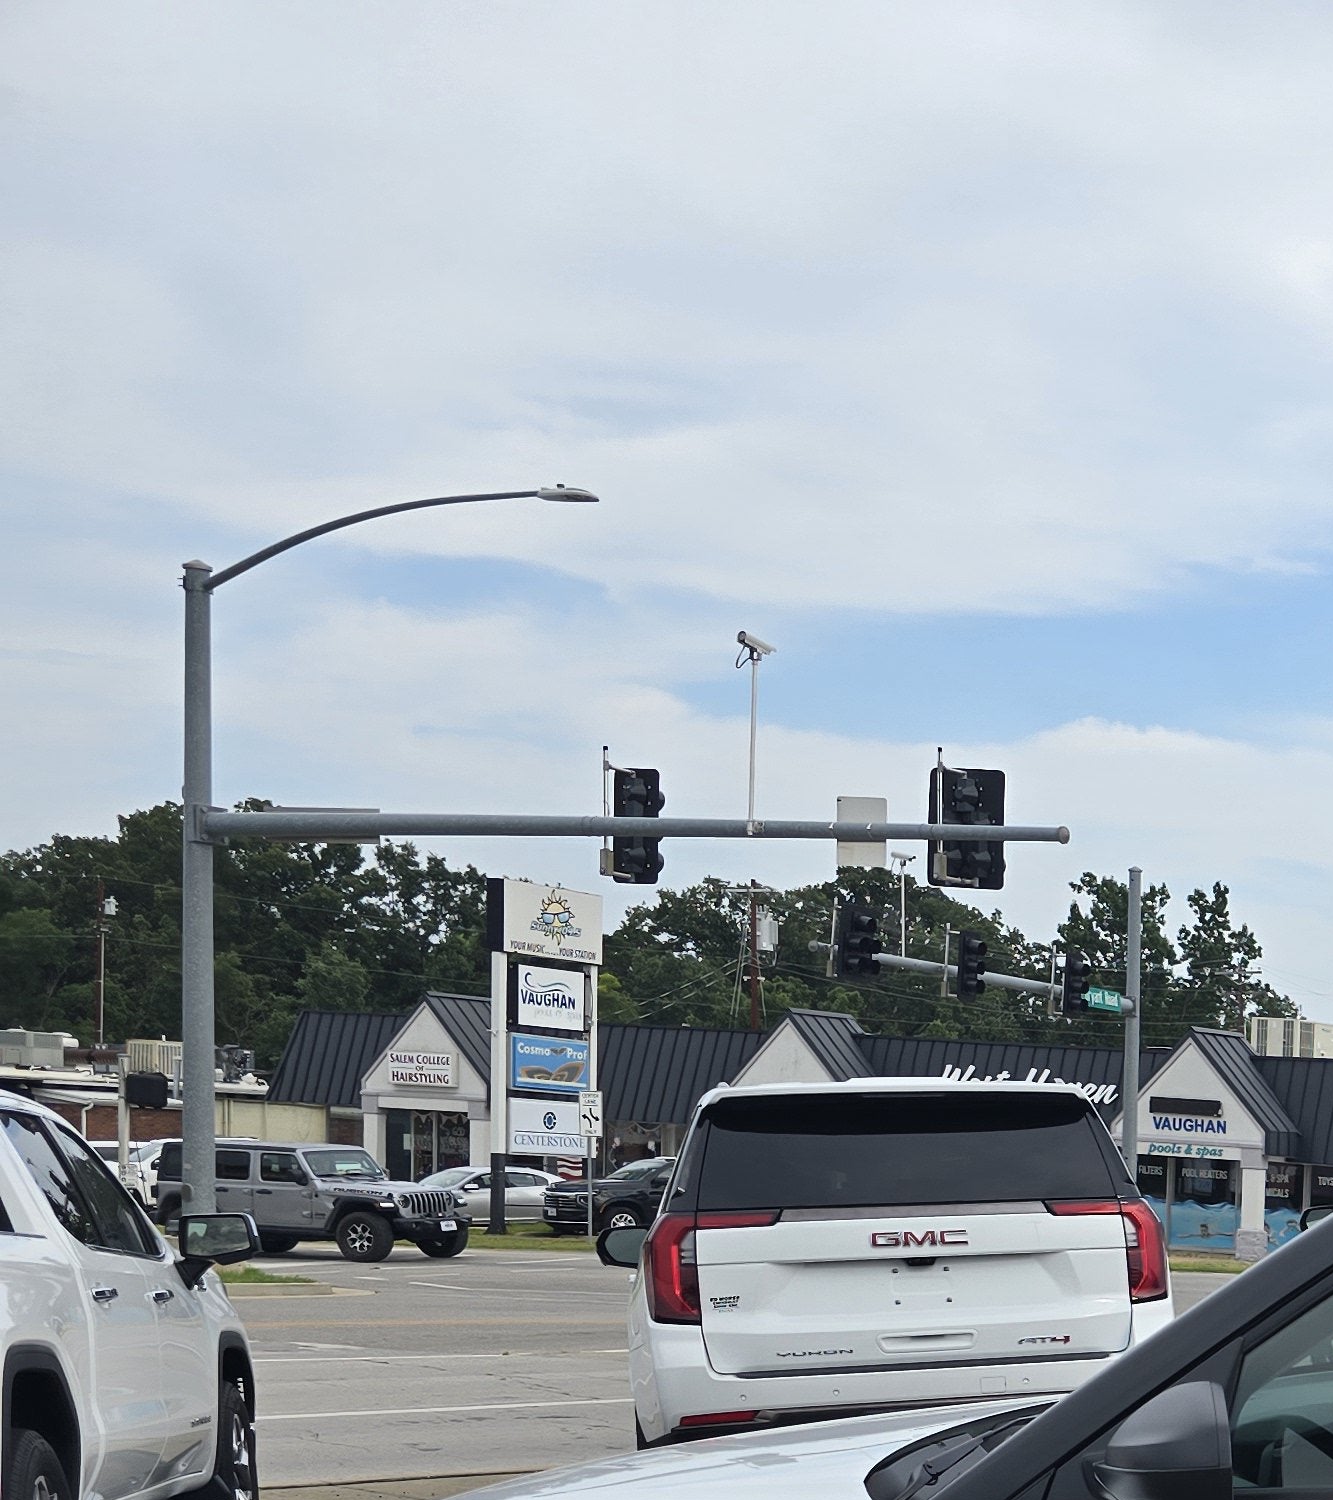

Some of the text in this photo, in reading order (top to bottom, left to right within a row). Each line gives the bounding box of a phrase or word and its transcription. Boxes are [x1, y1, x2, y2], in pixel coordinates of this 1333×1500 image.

[510, 940, 526, 950] YOUR
[574, 949, 597, 960] STATION
[520, 988, 576, 1010] VAUGHAN
[517, 1042, 588, 1060] Cosmo Prof
[390, 1053, 450, 1065] SALEM COLLEGE
[391, 1071, 449, 1084] HAIRSTYLING
[1152, 1116, 1227, 1134] VAUGHAN
[514, 1134, 585, 1149] CENTERSTONE
[1147, 1143, 1224, 1158] pools & spas
[1181, 1167, 1228, 1180] POOL HEATERS
[871, 1229, 969, 1248] GMC
[1018, 1335, 1071, 1345] AT4
[775, 1349, 854, 1358] YUKON
